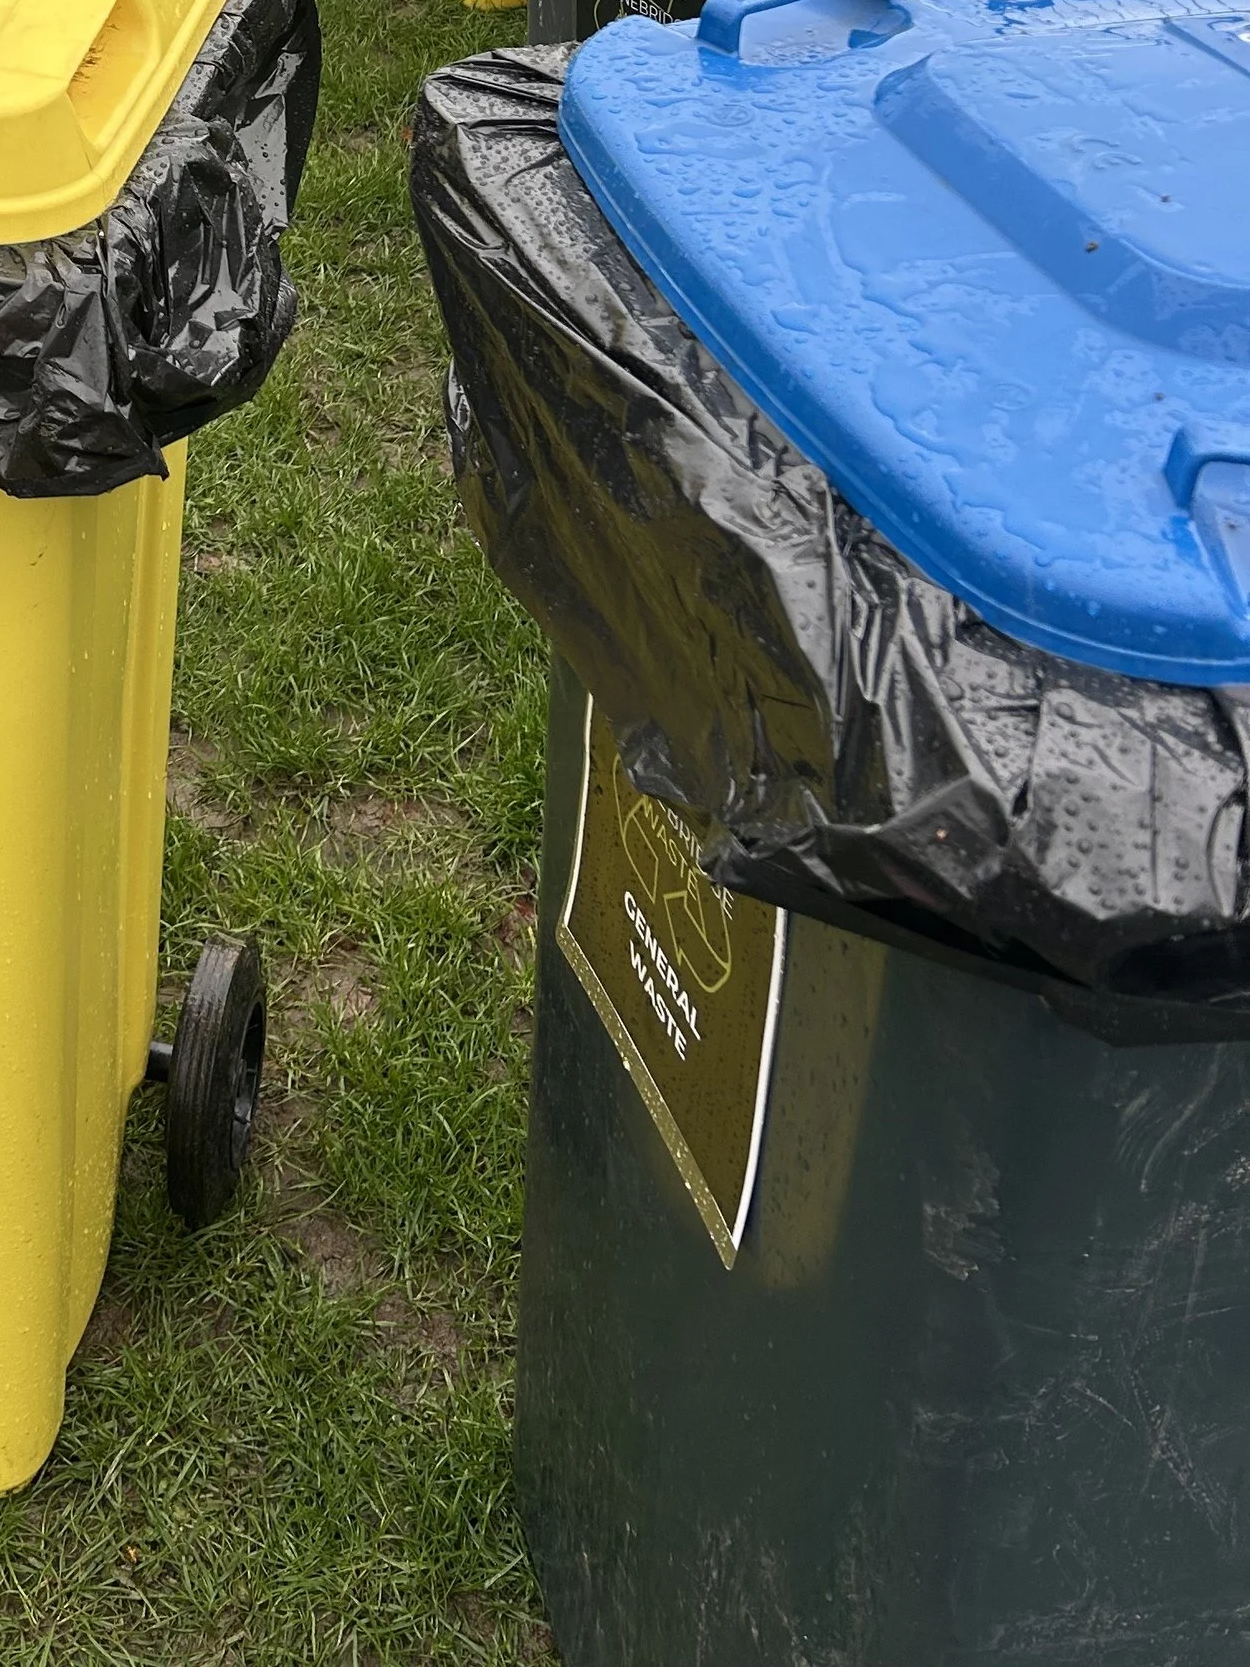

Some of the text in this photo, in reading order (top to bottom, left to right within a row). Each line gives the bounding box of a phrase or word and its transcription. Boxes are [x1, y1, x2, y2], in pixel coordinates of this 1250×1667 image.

[640, 793, 698, 902] WASTE
[623, 891, 701, 1041] GENERAL
[628, 939, 687, 1062] WASTE
